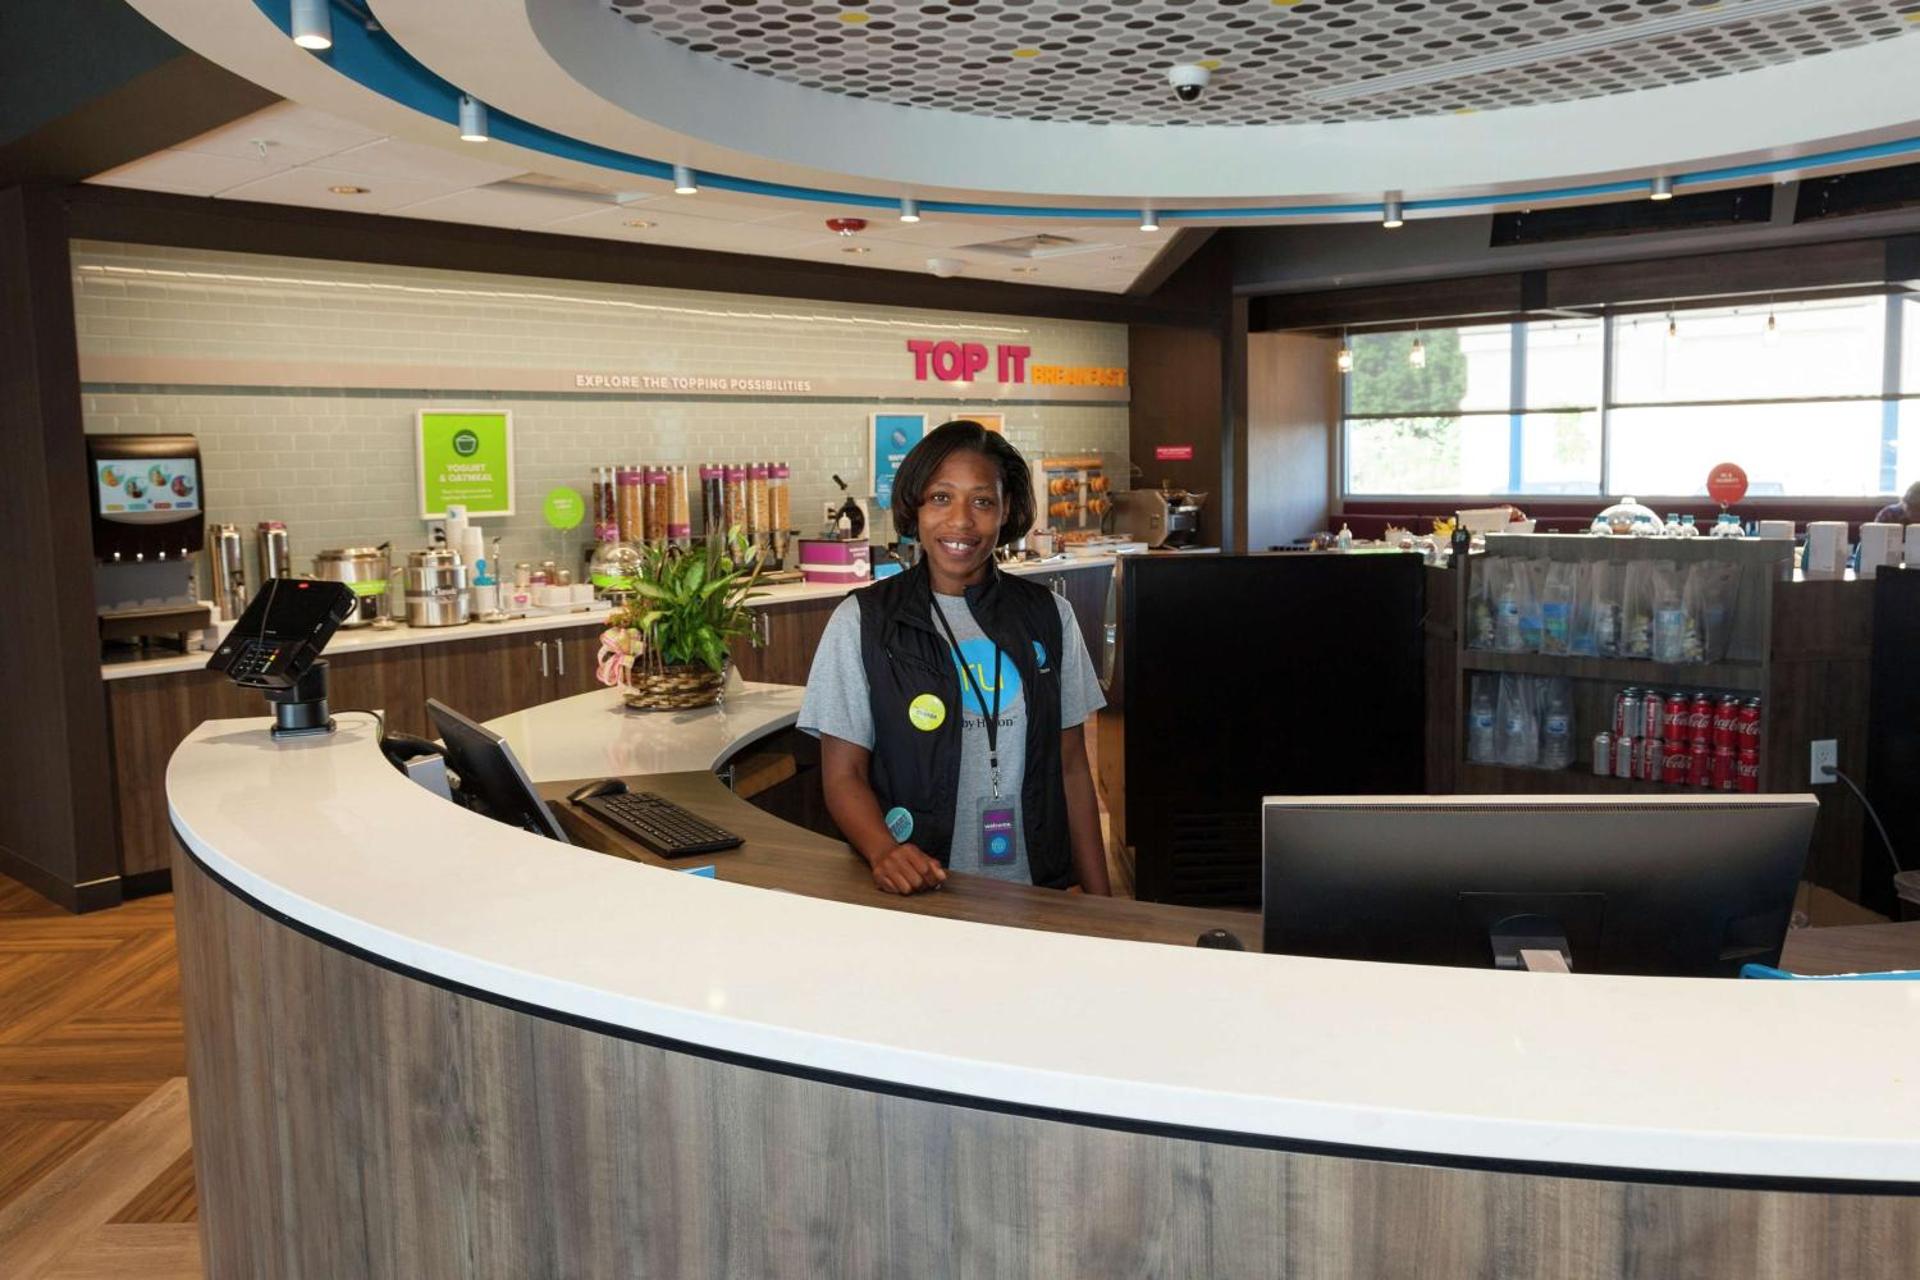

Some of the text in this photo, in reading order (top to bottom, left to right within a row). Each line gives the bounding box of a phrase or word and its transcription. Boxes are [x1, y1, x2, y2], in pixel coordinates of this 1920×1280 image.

[907, 339, 1031, 384] TOP IT
[576, 374, 812, 392] EXPLORE THE TOPPING POSSIBILITIES
[1031, 365, 1127, 387] BREAKFAST
[977, 716, 1014, 729] Hon
